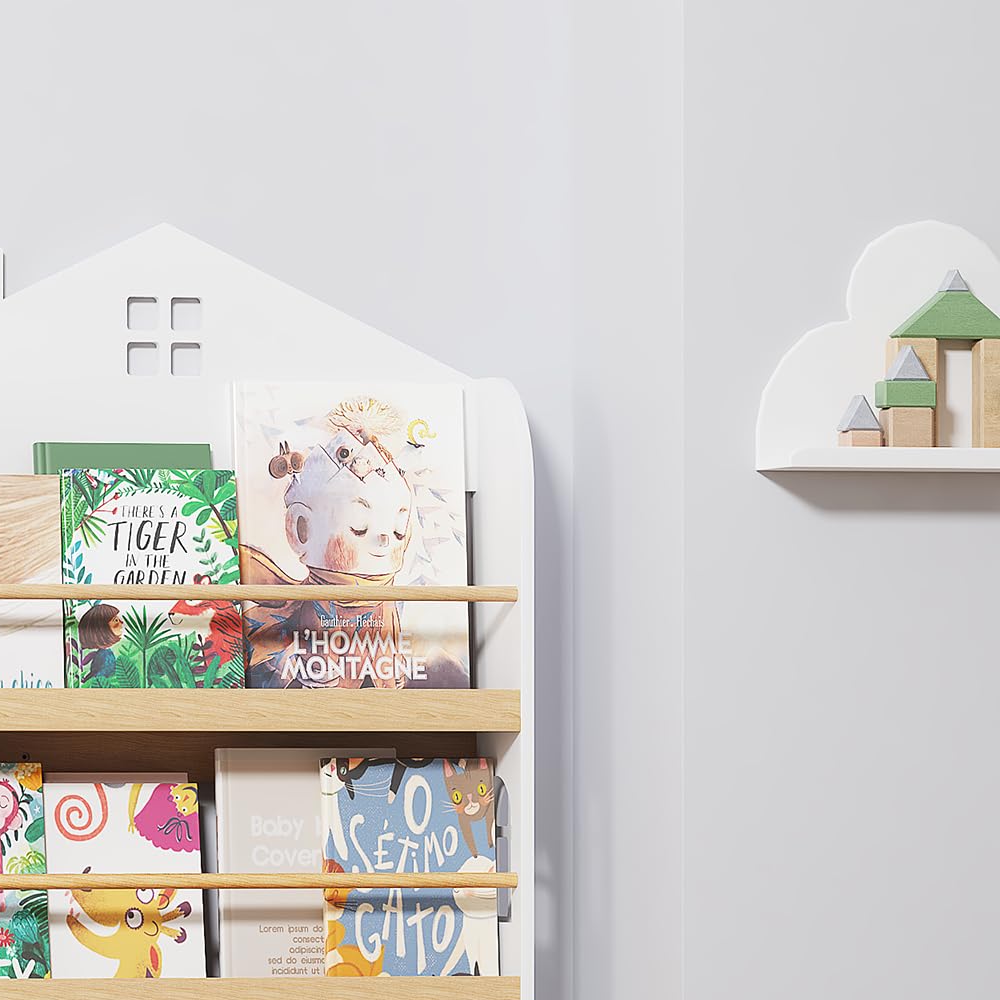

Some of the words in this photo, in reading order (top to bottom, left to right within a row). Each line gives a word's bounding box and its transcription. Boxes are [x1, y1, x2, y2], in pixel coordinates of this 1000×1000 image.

[171, 505, 178, 519] A
[107, 519, 188, 553] TIGER
[126, 553, 137, 567] IN
[145, 553, 170, 568] THE
[113, 569, 187, 585] GARDEN
[292, 628, 412, 660] L'HOMME
[280, 655, 428, 681] MONTAGNE
[403, 774, 432, 835] O
[251, 815, 304, 841] Baby
[259, 925, 284, 933] Lorem
[288, 925, 309, 934] ipsum
[354, 886, 455, 975] GATO
[268, 957, 283, 965] sed
[286, 957, 297, 965] do
[311, 967, 320, 975] ut
